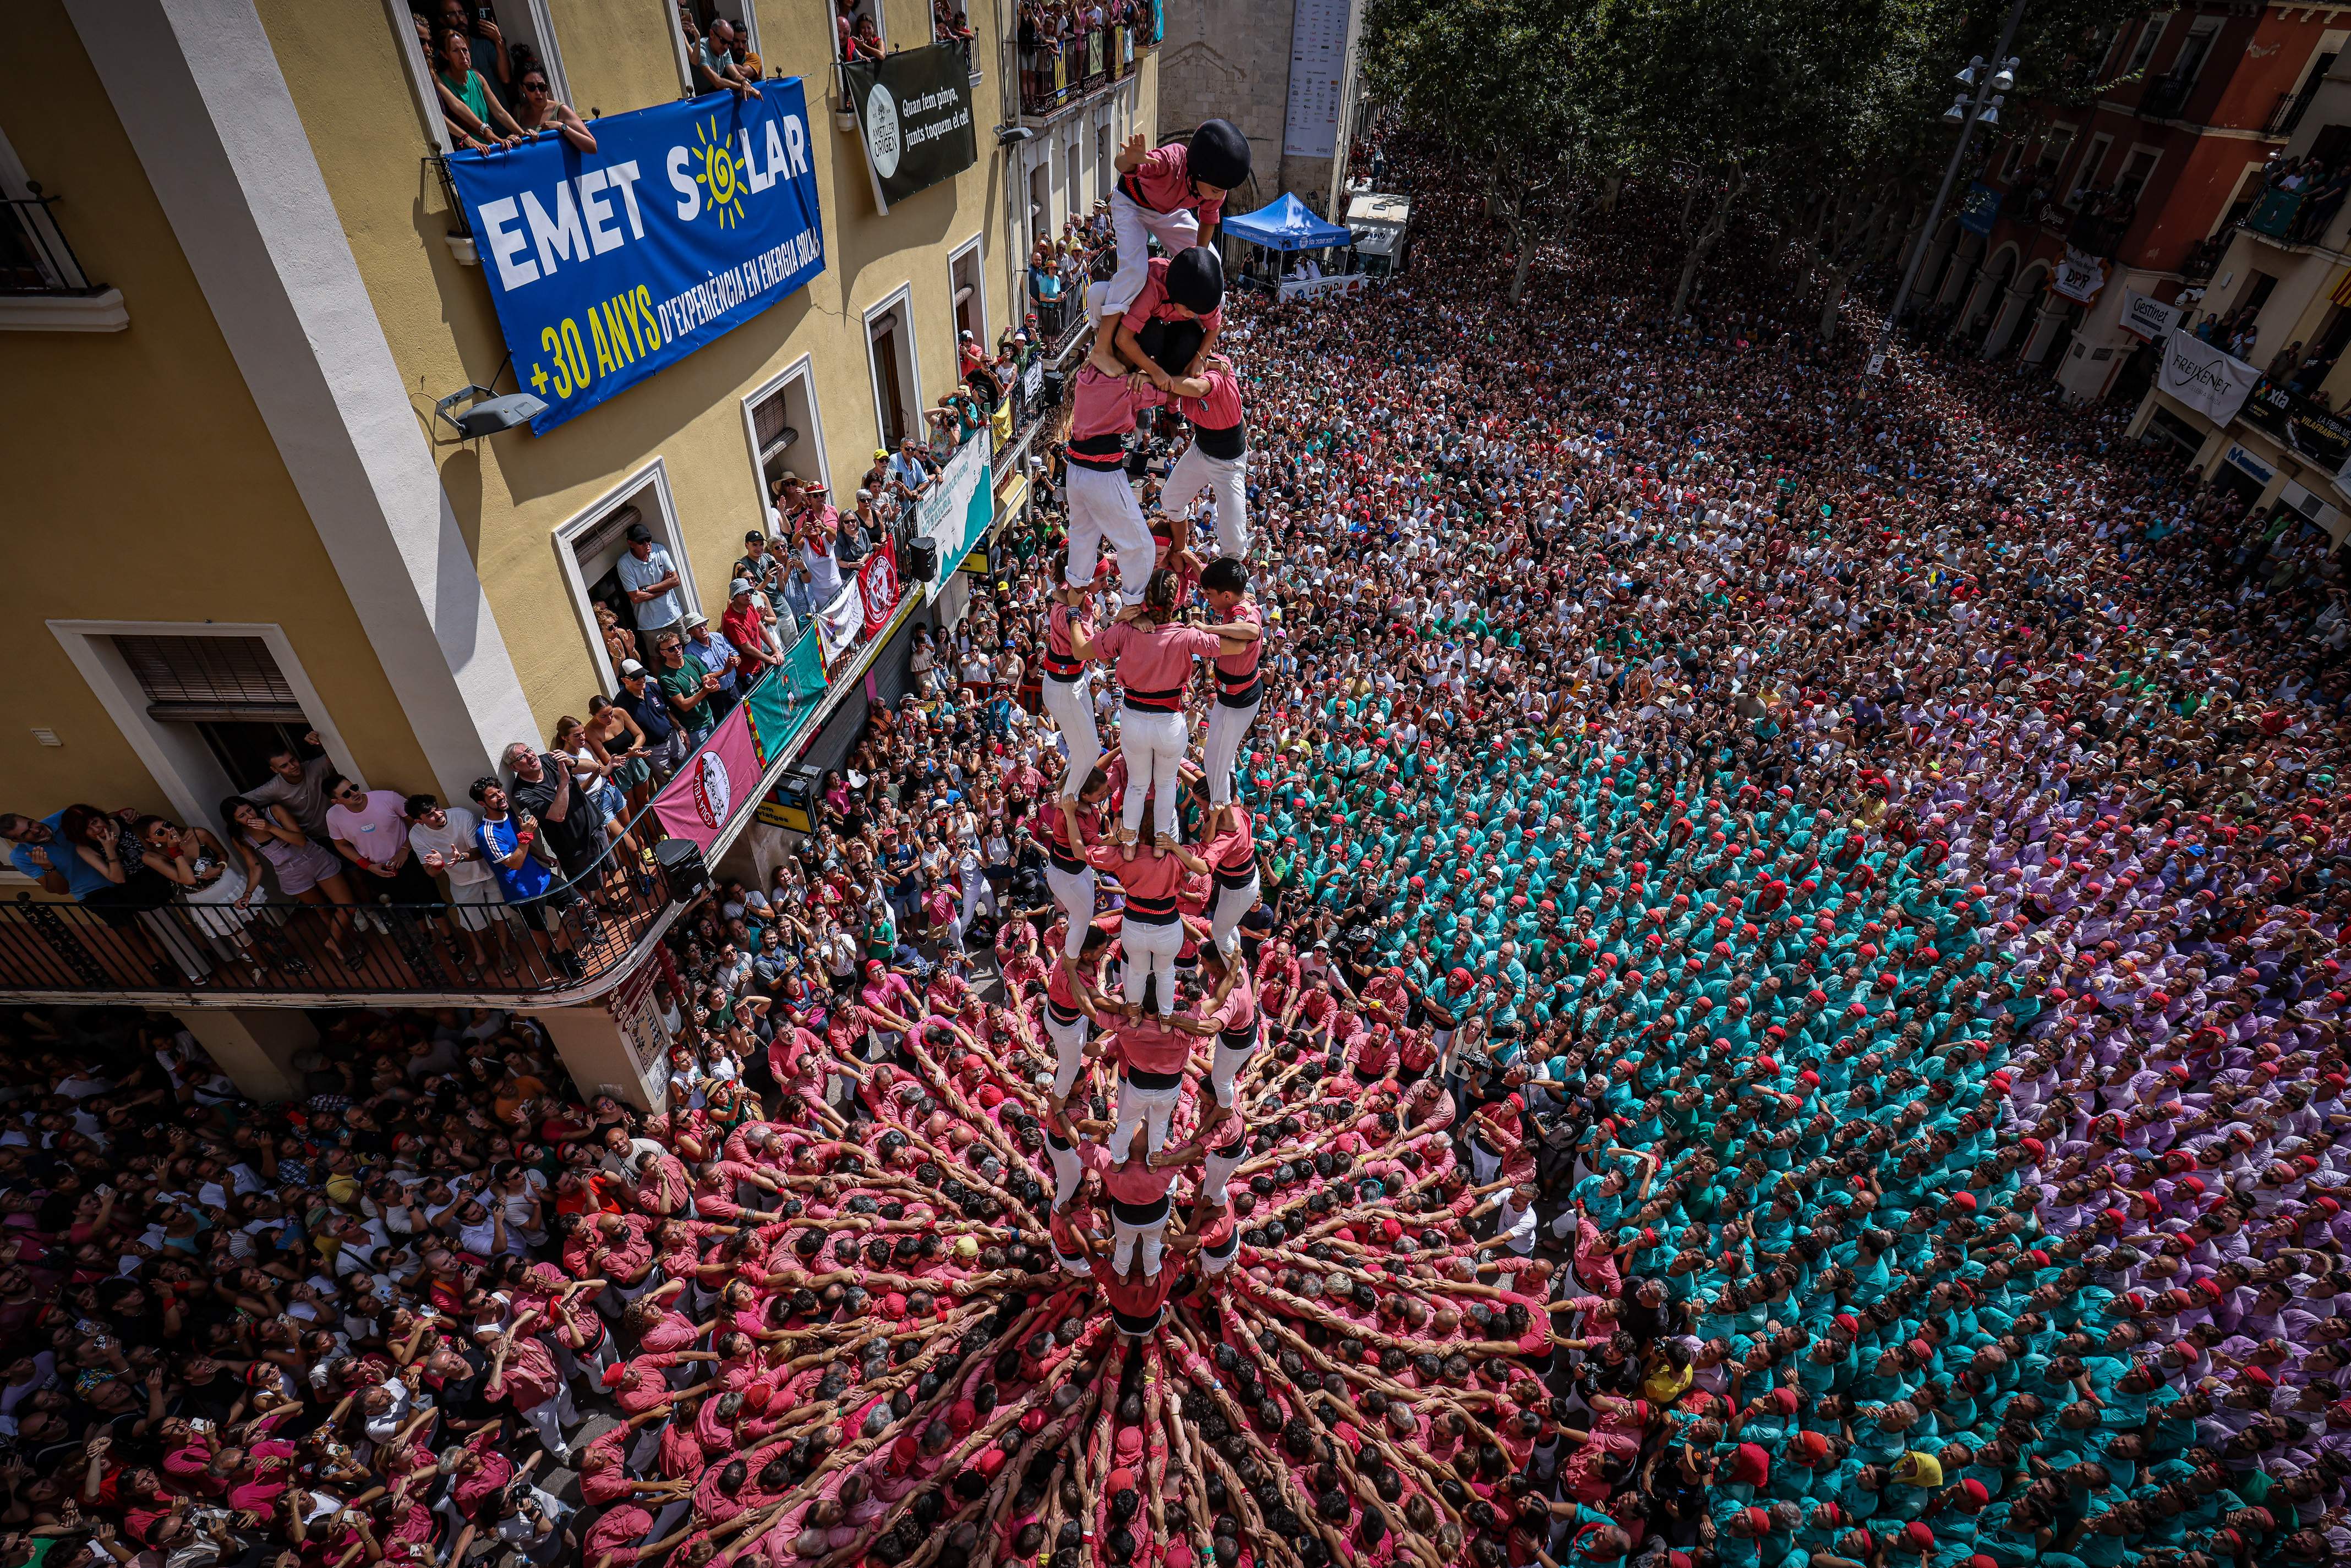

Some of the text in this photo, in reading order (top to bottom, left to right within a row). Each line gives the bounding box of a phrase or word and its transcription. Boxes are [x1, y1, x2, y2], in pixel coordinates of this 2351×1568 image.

[903, 86, 958, 118] Quan fem pinya,
[873, 122, 895, 141] AMETLLER
[905, 107, 969, 152] junts toquem el cel!
[874, 135, 898, 157] ORIGEN
[478, 161, 644, 291] EMET
[2065, 268, 2090, 288] DPR
[531, 317, 591, 399] +30
[588, 284, 661, 379] ANYS
[658, 270, 746, 344] D'EXPERIÈNCIA
[742, 260, 762, 303] EN
[758, 238, 799, 293] ENERGIA
[2134, 298, 2169, 324] Gestinet
[2173, 354, 2232, 395] FREIXENET
[2267, 388, 2290, 409] xta
[2317, 415, 2351, 440] LA FIBRA ME
[922, 520, 930, 536] NO
[786, 708, 803, 730] VILAFRANCA
[717, 761, 725, 778] Xiquets
[699, 802, 713, 825] COLLA
[639, 949, 654, 969] Vinseum
[640, 956, 658, 984] Casa Gomà
[638, 993, 646, 1006] Ruta
[645, 966, 662, 994] Modernista
[646, 1043, 664, 1071] CASTELLERA
[624, 1167, 634, 1177] adidas
